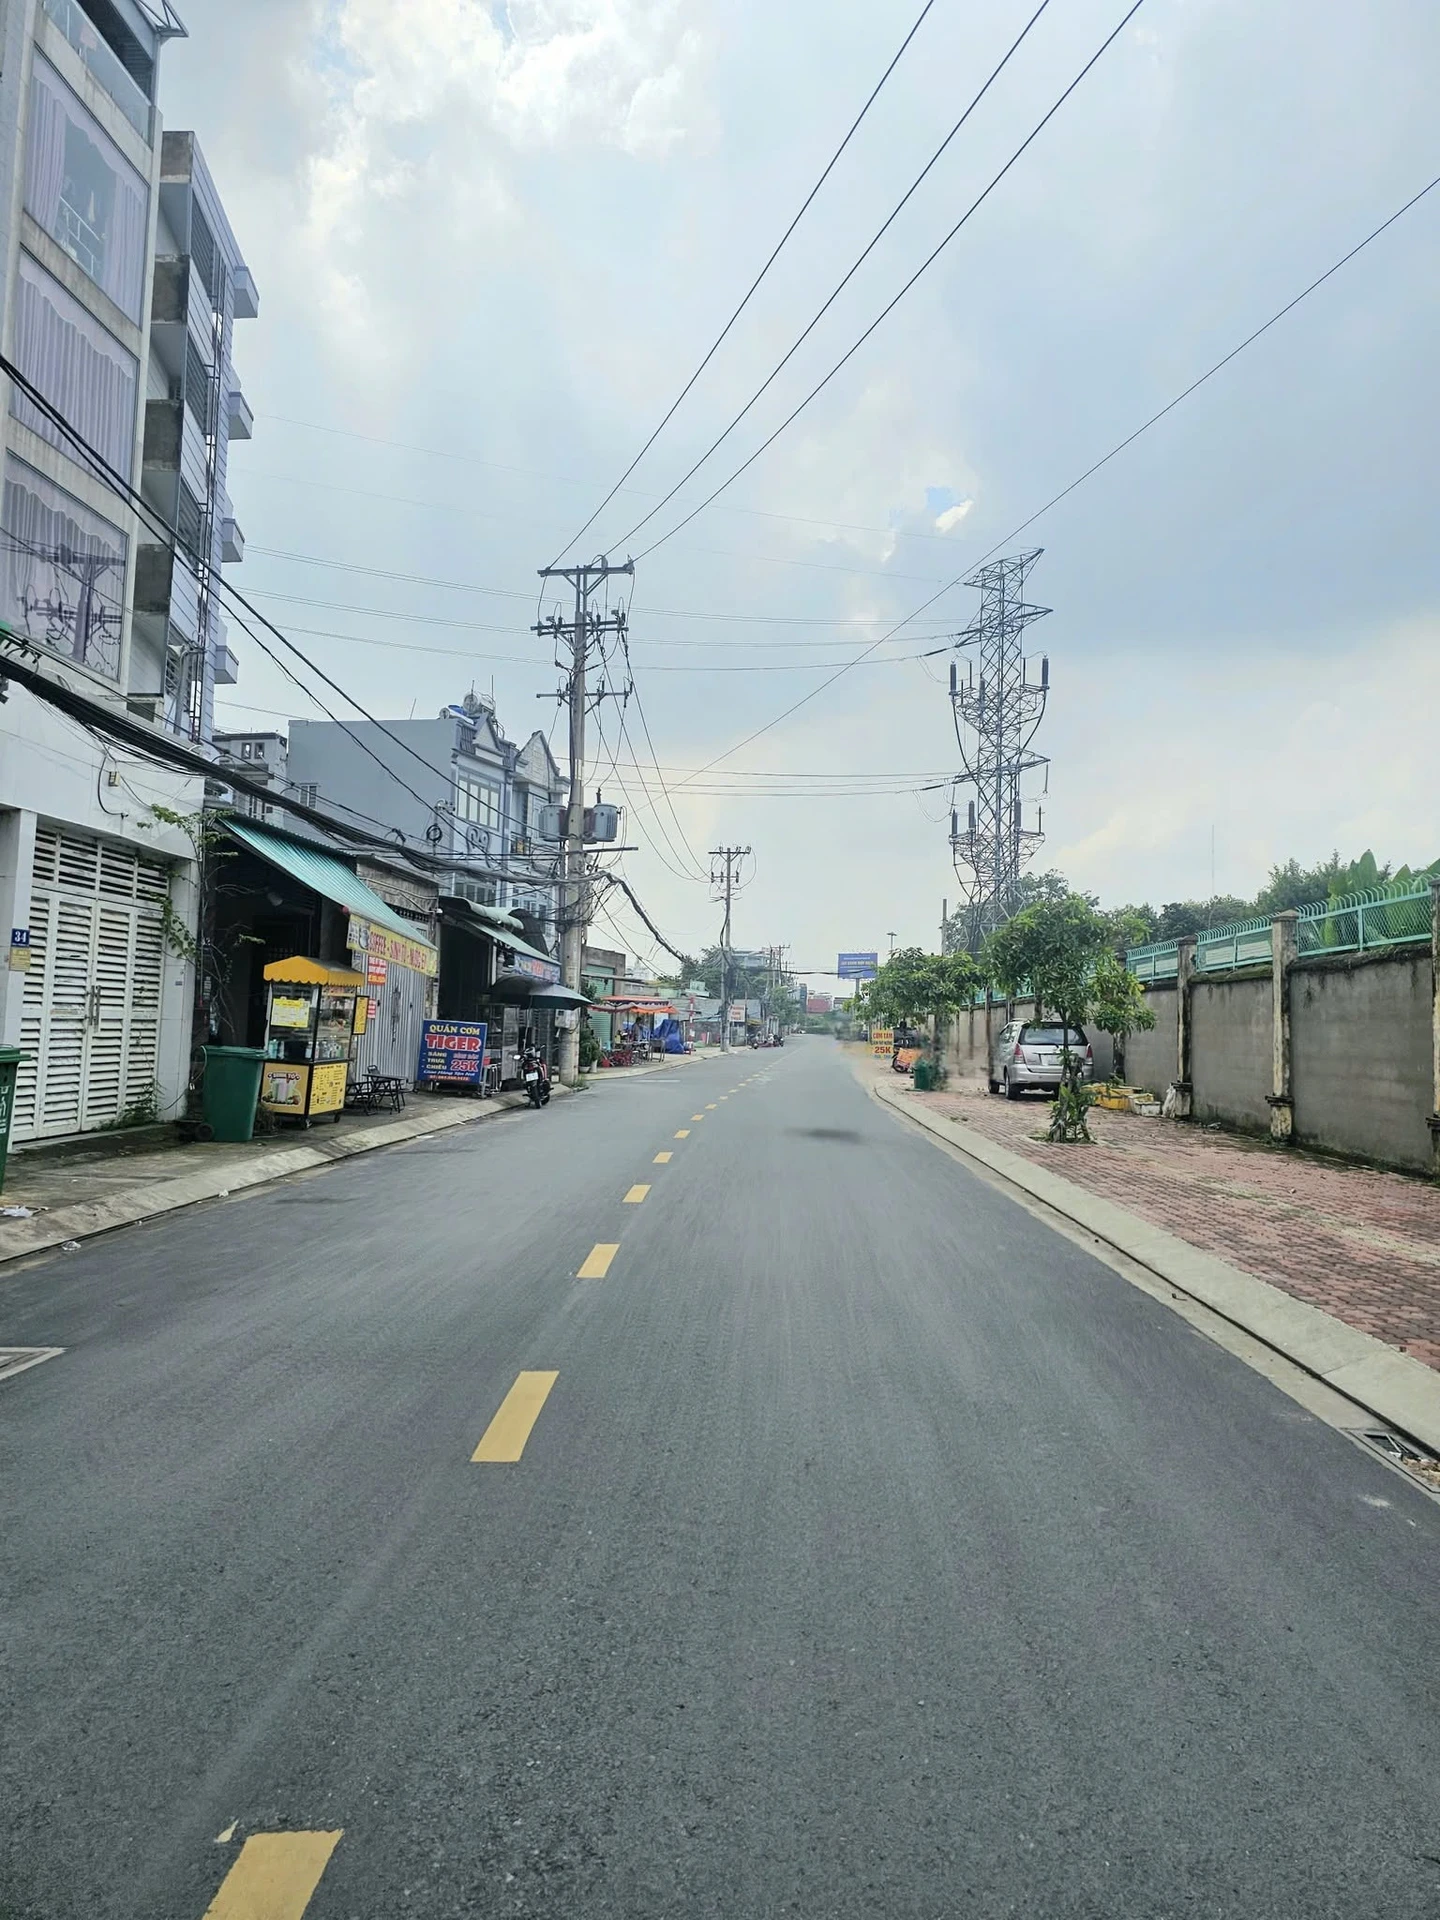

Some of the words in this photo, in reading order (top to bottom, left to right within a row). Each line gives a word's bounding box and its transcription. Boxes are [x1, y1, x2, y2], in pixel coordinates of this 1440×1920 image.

[14, 930, 26, 942] 34
[429, 1024, 457, 1033] QUÁN
[460, 1027, 480, 1035] CƠM
[425, 1034, 481, 1052] TIGER
[451, 1060, 479, 1072] 25K
